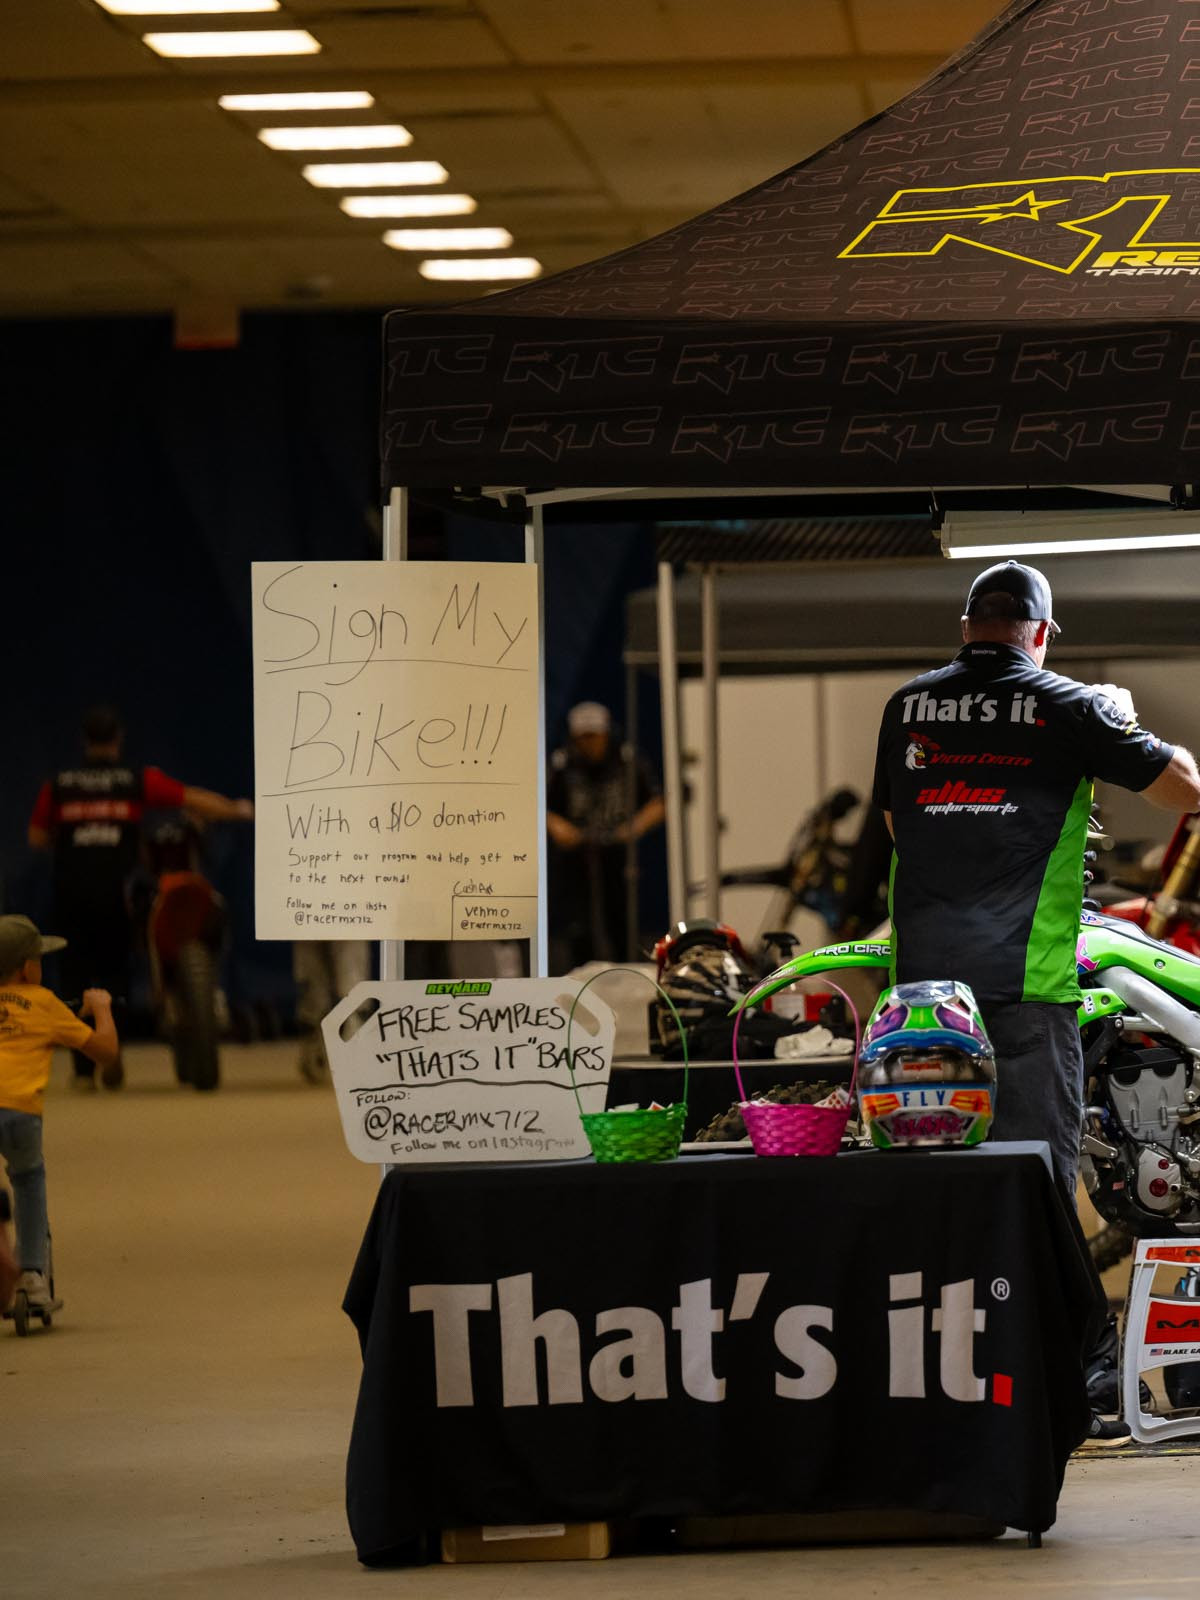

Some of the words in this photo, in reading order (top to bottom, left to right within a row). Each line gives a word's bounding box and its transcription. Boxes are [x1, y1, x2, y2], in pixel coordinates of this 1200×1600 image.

[262, 565, 408, 685] Sign
[431, 581, 528, 664] My
[901, 691, 997, 723] That's
[1010, 692, 1046, 727] it.
[284, 690, 508, 788] Bike!!!
[924, 802, 1019, 815] motorsports
[286, 801, 351, 839] With
[369, 815, 380, 832] a
[389, 801, 421, 832] $10
[433, 801, 506, 829] donation
[288, 848, 342, 868] Support
[353, 853, 369, 861] our
[382, 853, 417, 863] program
[426, 852, 442, 862] and
[449, 852, 470, 865] help
[480, 852, 502, 865] get
[513, 853, 527, 861] me
[289, 872, 301, 883] to
[308, 872, 327, 884] the
[340, 874, 364, 883] next
[376, 873, 409, 883] round!
[286, 897, 312, 909] Follow
[321, 902, 336, 910] me
[344, 903, 357, 911] on
[812, 944, 850, 957] PRO
[854, 944, 891, 956] CIRC
[426, 981, 492, 997] REYNARD
[378, 1004, 450, 1041] FREE
[459, 1002, 566, 1034] SAMPLES
[537, 1042, 606, 1071] BARS
[902, 1090, 945, 1107] FLY
[391, 1142, 436, 1155] Follow
[442, 1140, 461, 1150] me
[469, 1138, 488, 1149] on
[408, 1271, 838, 1408] That's
